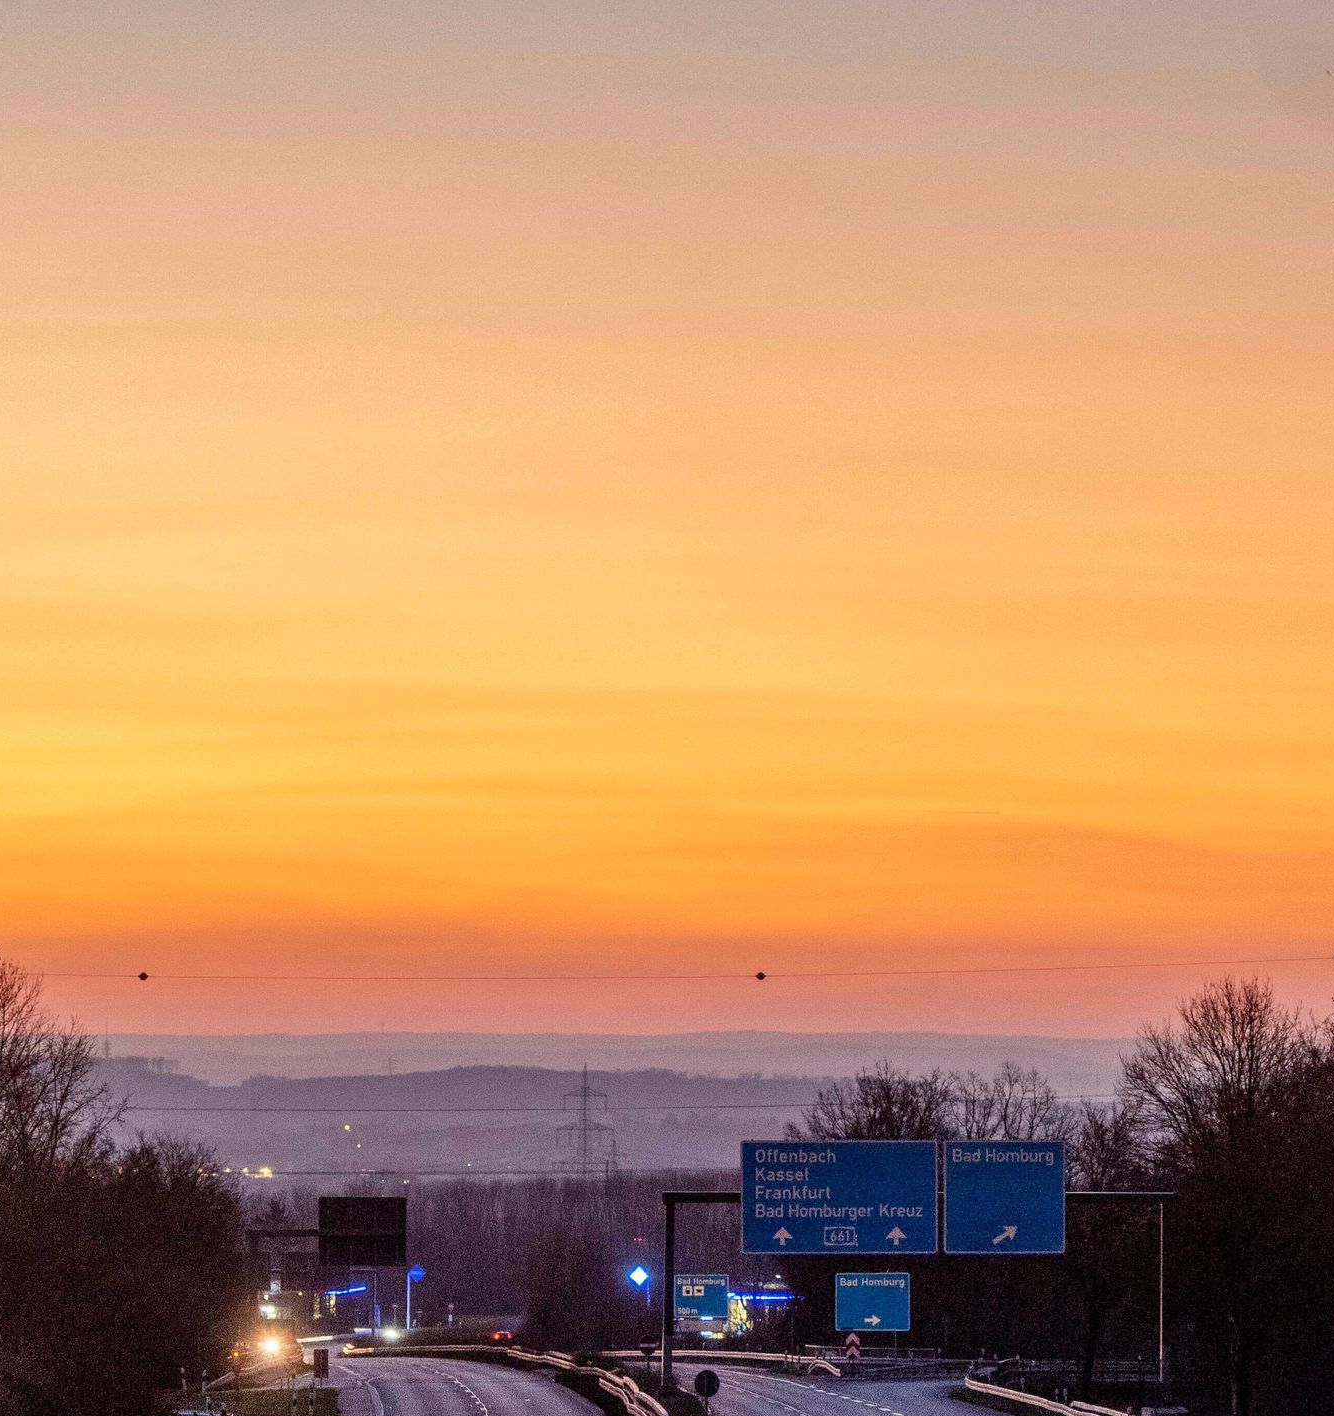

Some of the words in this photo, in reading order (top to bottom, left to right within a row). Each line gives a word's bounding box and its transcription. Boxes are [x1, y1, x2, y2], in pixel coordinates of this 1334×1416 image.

[755, 1149, 836, 1163] Offenbach
[952, 1148, 981, 1162] Bad
[986, 1148, 1054, 1166] Homburg
[755, 1167, 809, 1181] Kassel
[755, 1185, 831, 1200] Frankfurt
[755, 1203, 784, 1218] Bad
[788, 1203, 874, 1221] Homburger
[879, 1203, 924, 1218] Kreuz
[830, 1230, 851, 1242] 661
[677, 1277, 691, 1285] Bad
[693, 1277, 726, 1286] Homburg
[840, 1277, 858, 1286] Bad
[861, 1277, 905, 1288] Homburg
[677, 1307, 691, 1315] 500
